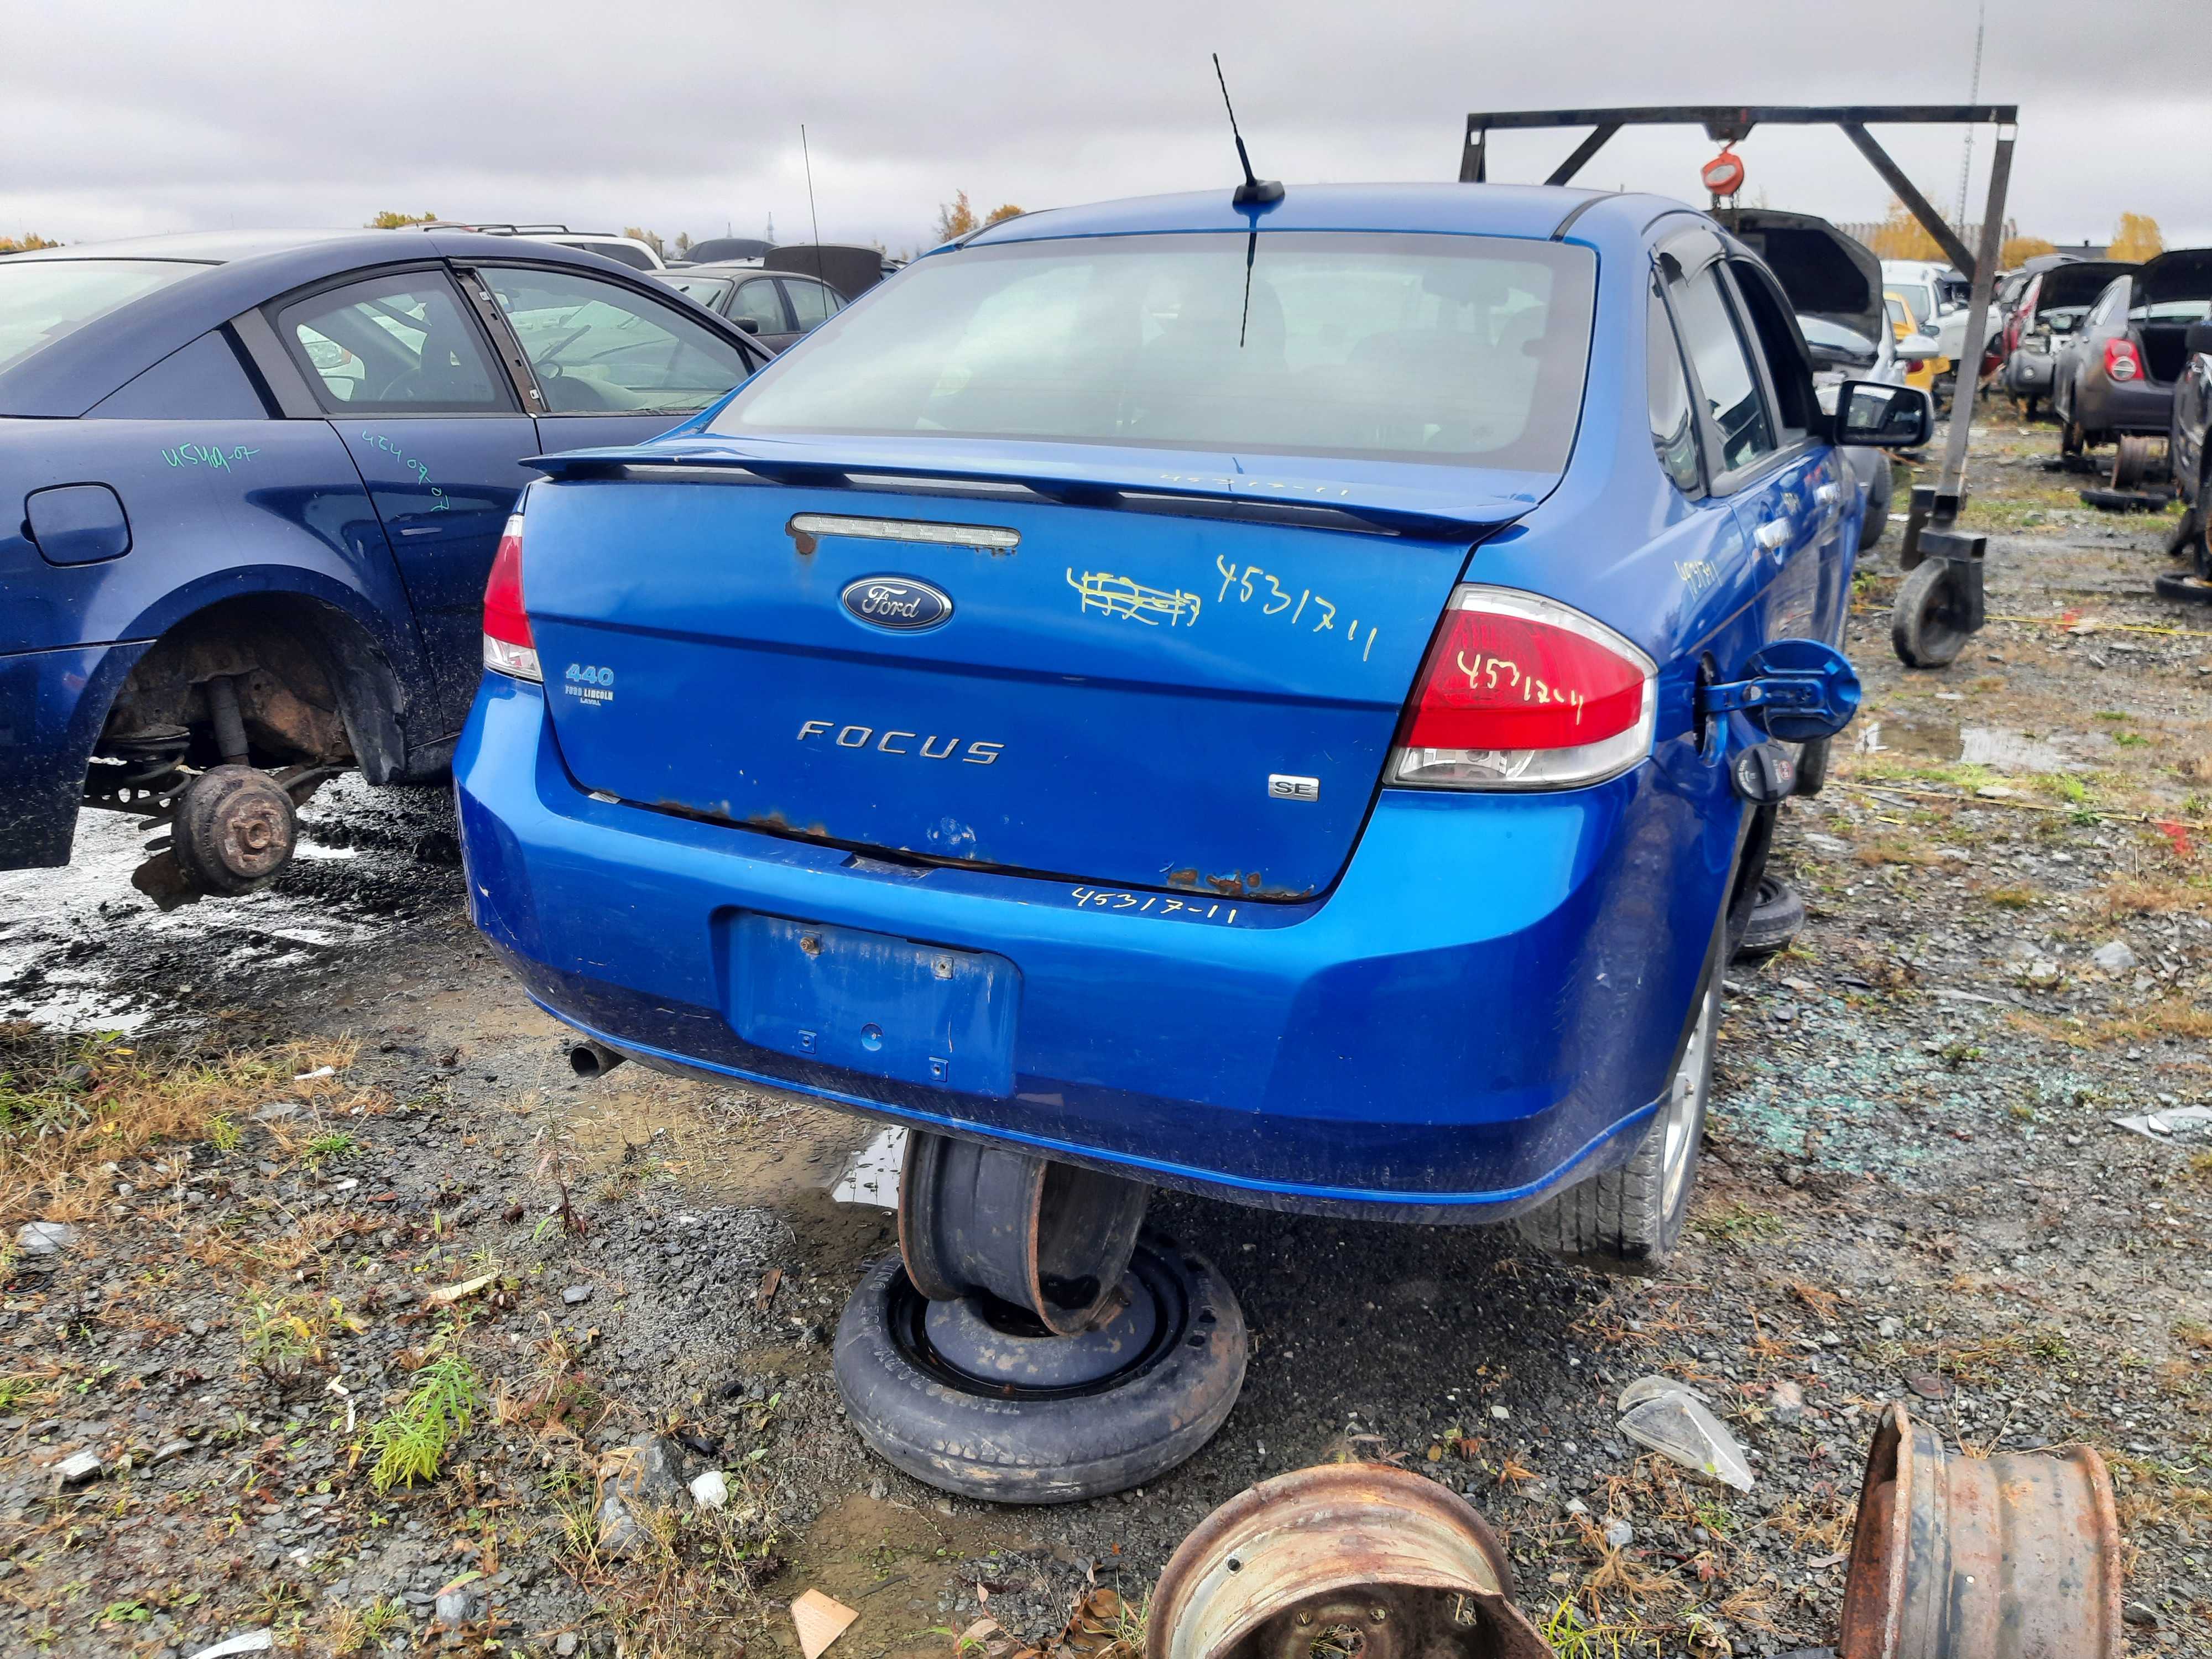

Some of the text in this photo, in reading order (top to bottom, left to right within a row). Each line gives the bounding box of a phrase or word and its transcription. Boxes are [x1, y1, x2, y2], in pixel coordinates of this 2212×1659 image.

[862, 585, 921, 619] Ford
[566, 664, 614, 686] 440
[565, 685, 614, 701] FORD LINCOLN
[796, 720, 1005, 765] FOCUS
[1274, 781, 1312, 797] SE
[1071, 887, 1238, 924] 45317-11
